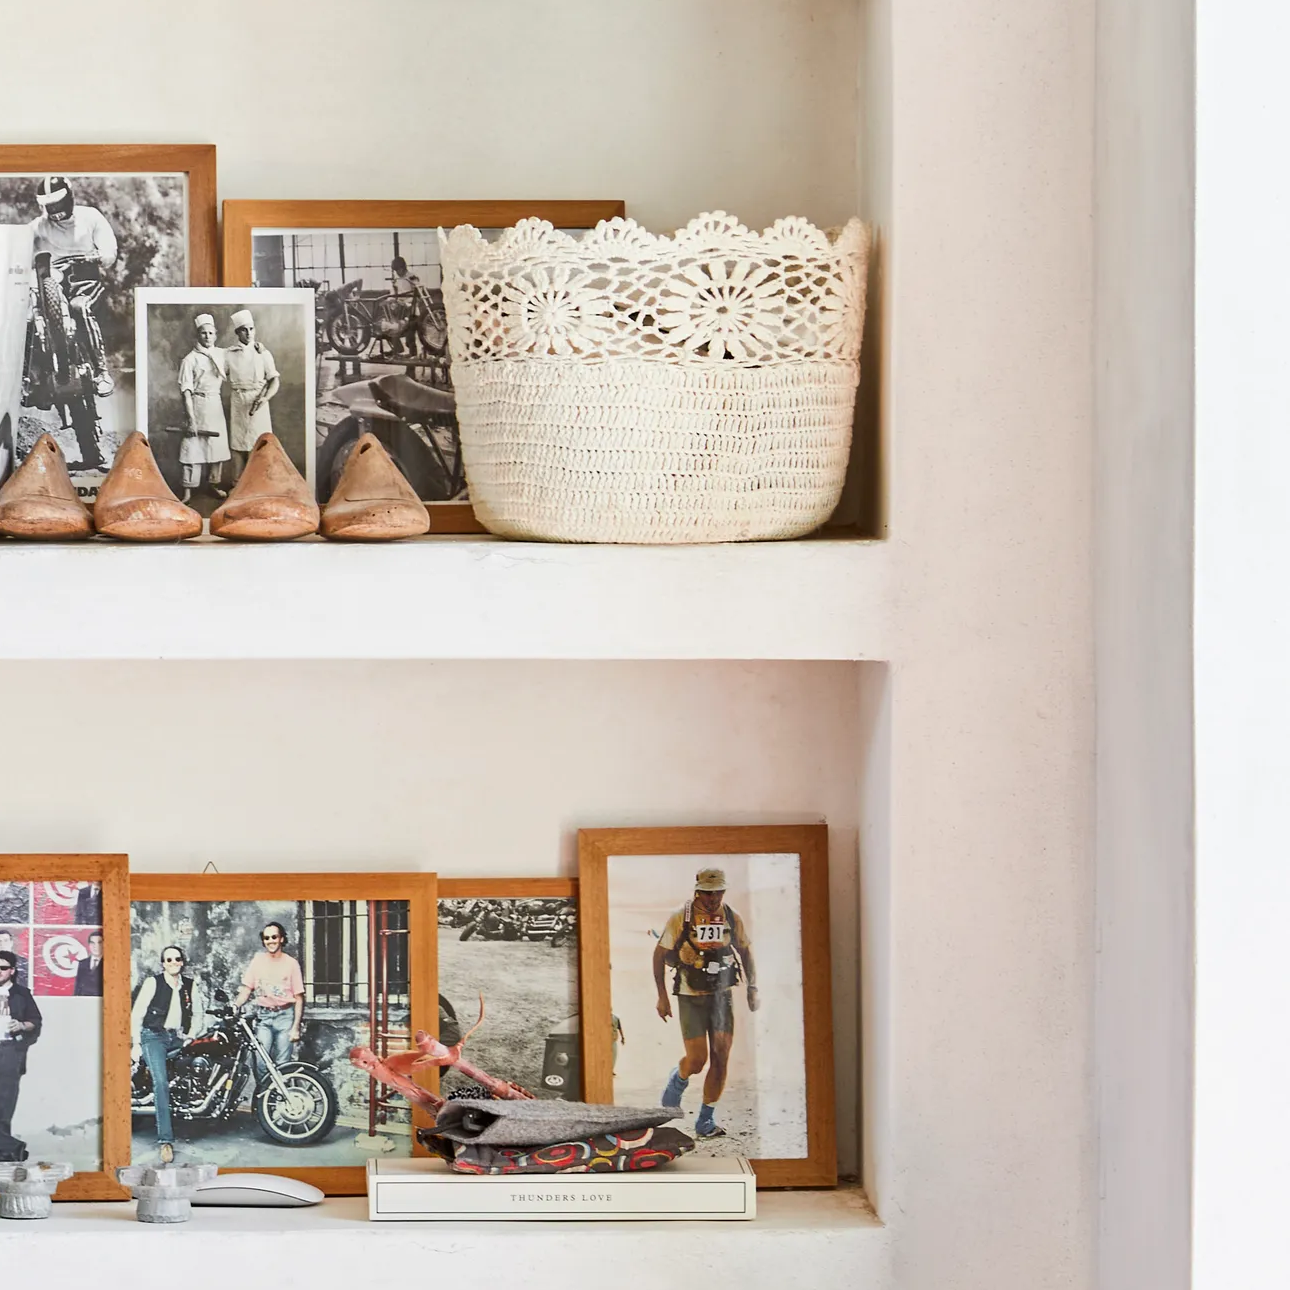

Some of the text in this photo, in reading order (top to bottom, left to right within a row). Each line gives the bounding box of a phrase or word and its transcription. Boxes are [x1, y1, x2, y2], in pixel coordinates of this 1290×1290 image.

[700, 926, 721, 940] 731
[510, 1194, 613, 1202] THUNDERS LOVE
